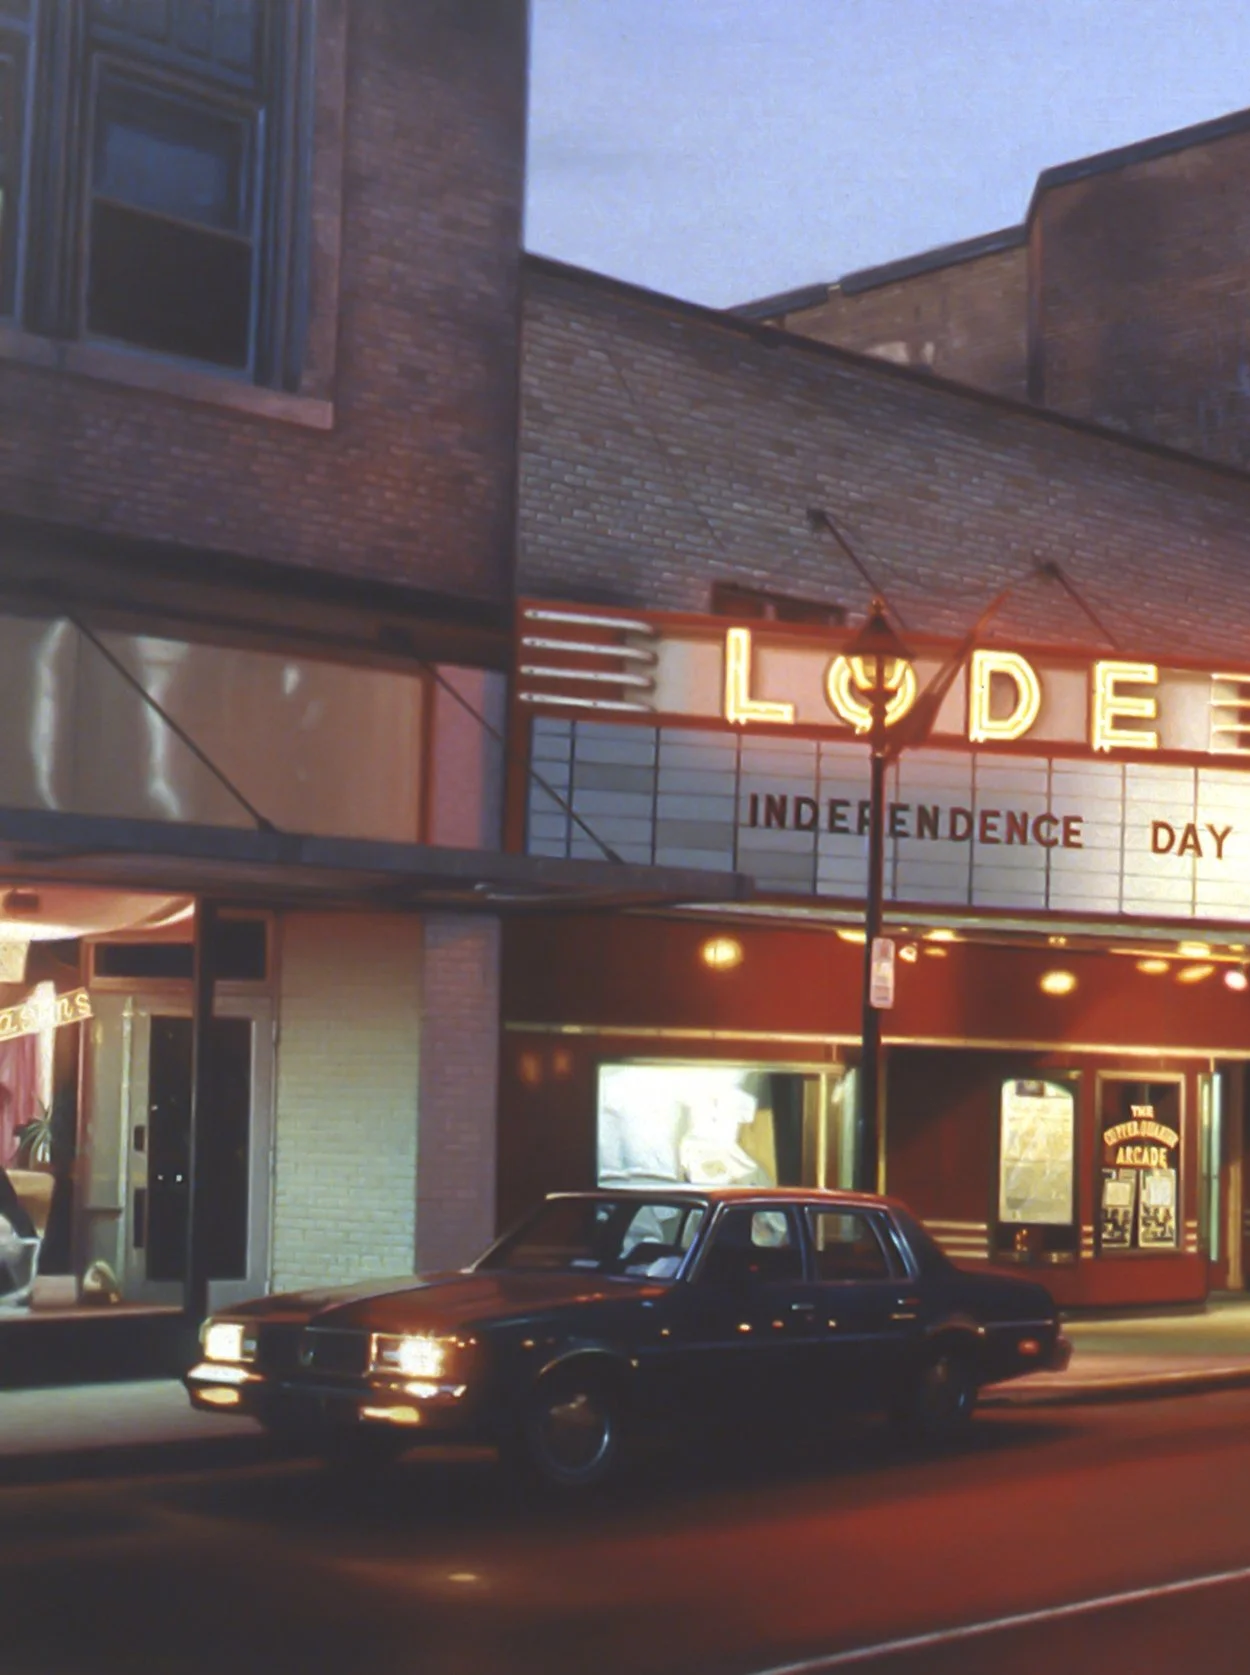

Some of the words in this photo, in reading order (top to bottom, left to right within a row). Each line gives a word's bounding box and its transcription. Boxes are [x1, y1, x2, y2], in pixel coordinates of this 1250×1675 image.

[725, 627, 1159, 752] LODE
[748, 793, 1083, 848] INDEPENDENCE
[1150, 820, 1233, 860] DAY
[1115, 1146, 1168, 1169] ARCADE
